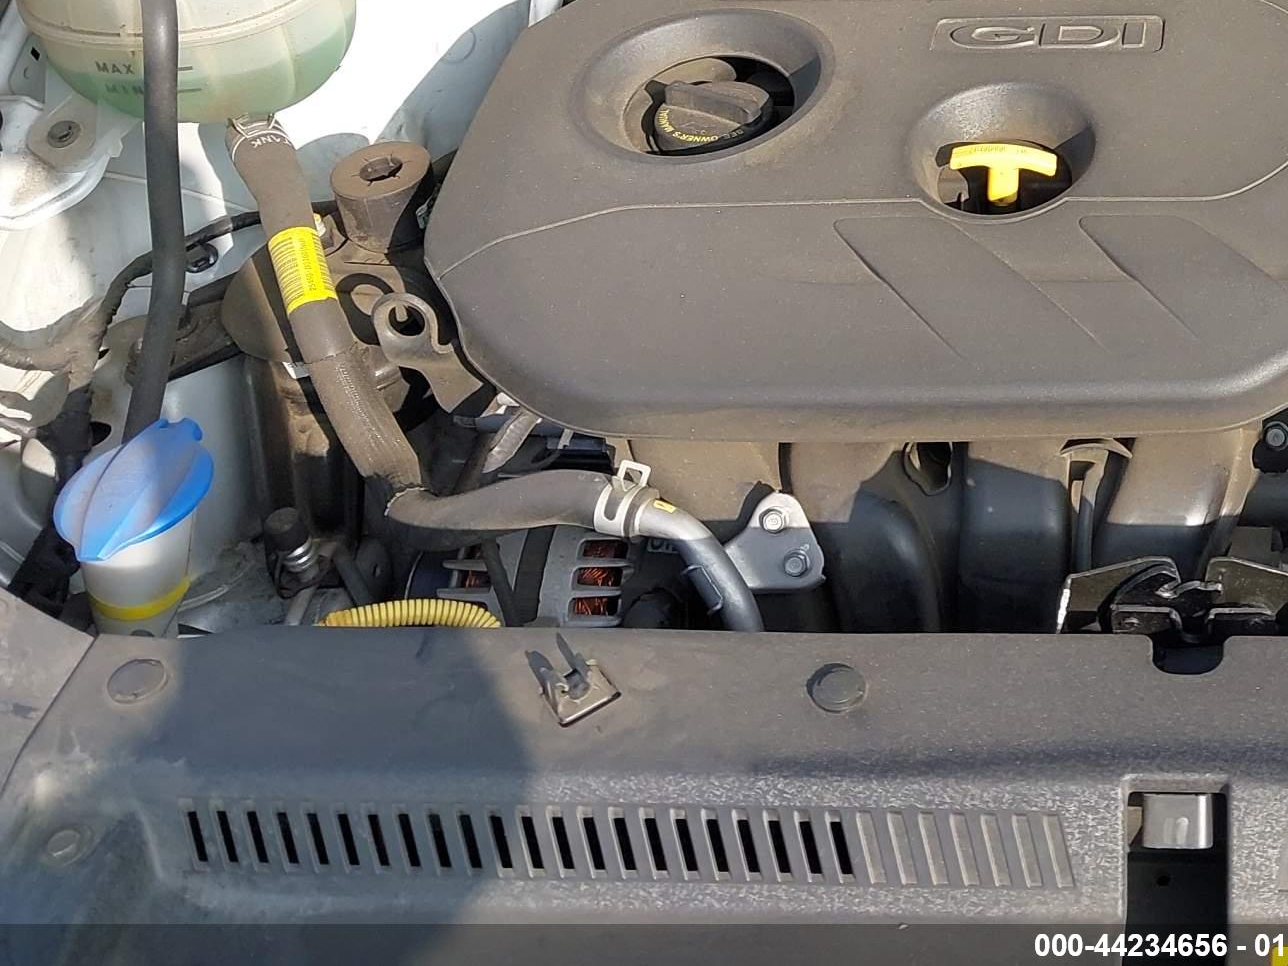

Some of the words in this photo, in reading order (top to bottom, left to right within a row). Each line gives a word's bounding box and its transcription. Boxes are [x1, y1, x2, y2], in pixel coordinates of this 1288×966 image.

[949, 21, 1147, 49] GDI
[94, 60, 136, 75] MAX
[657, 108, 675, 133] MANUAL
[672, 131, 719, 143] OWNER'S
